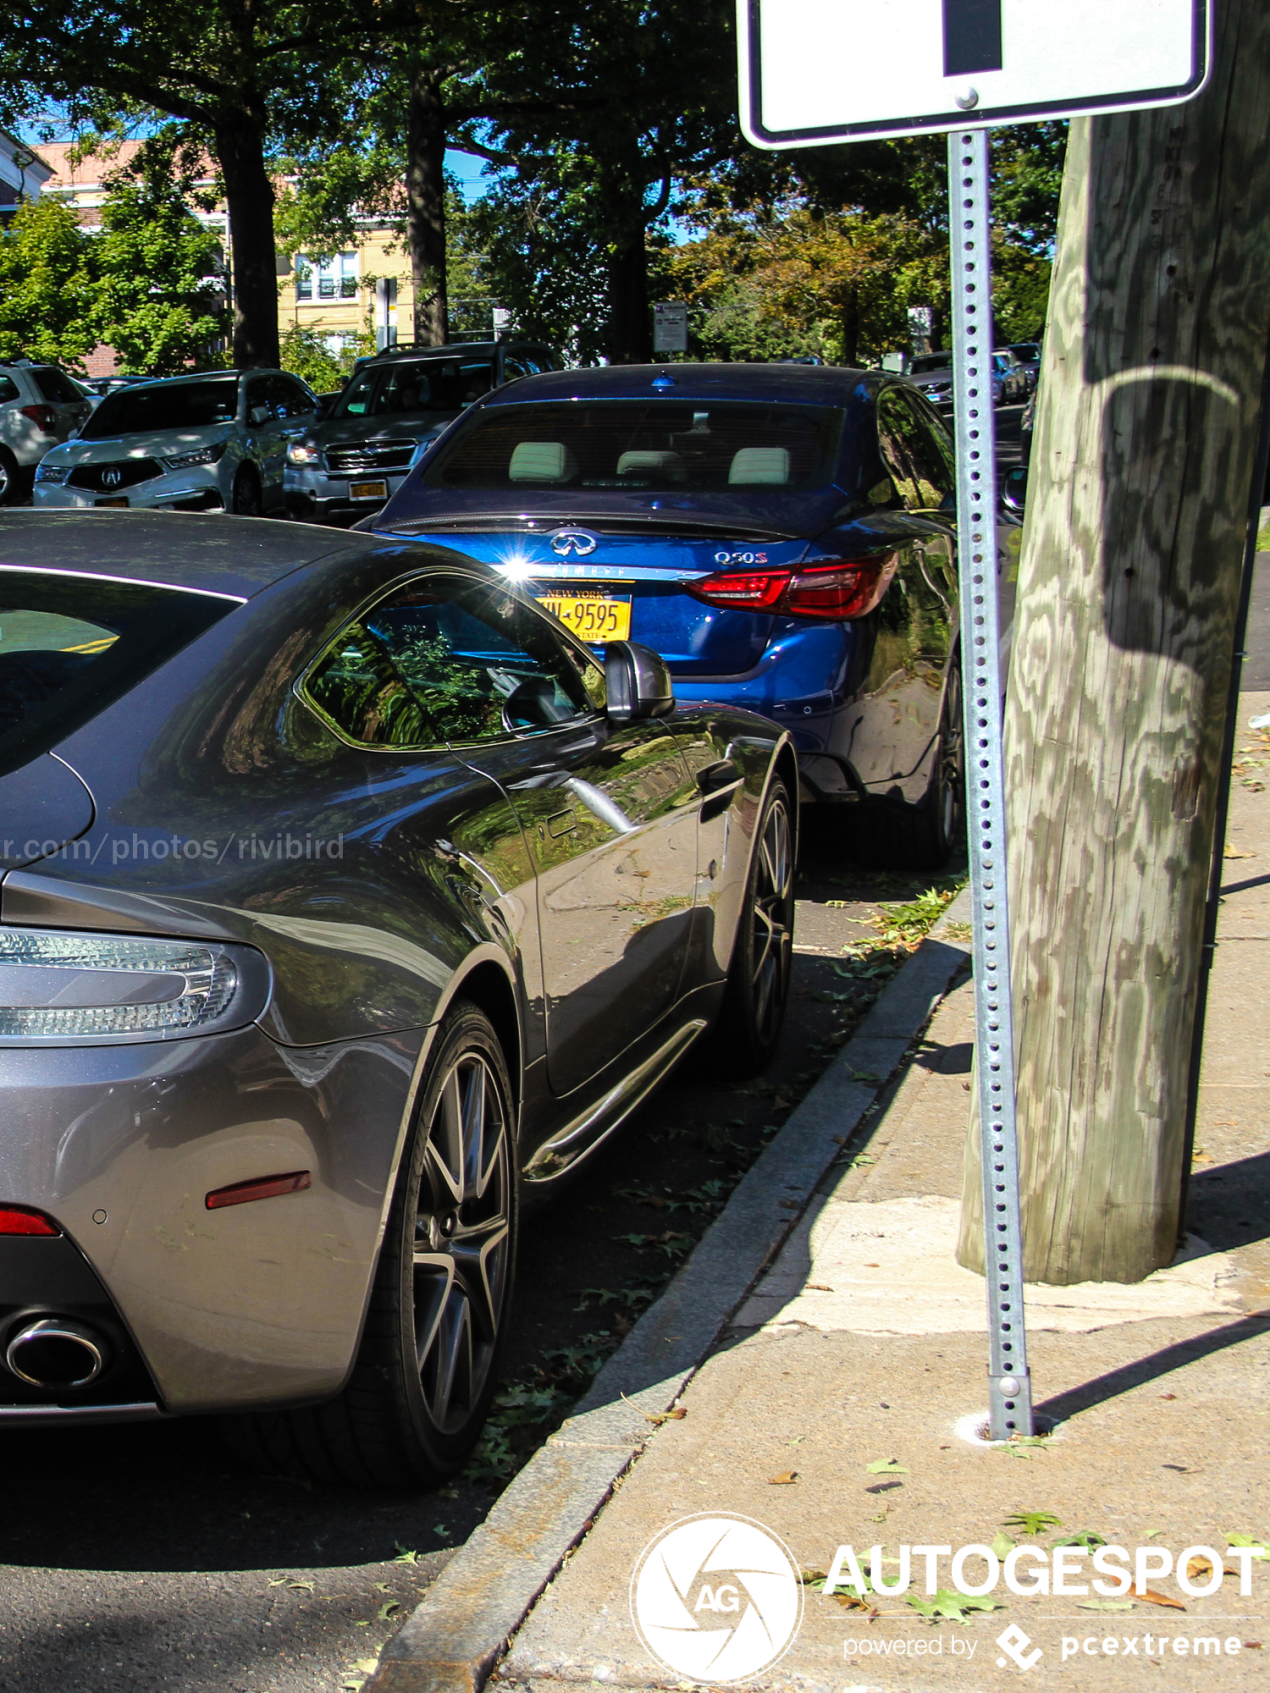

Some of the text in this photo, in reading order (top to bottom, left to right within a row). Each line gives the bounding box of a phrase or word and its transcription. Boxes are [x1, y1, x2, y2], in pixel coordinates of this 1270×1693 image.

[714, 552, 768, 566] Q50S
[548, 589, 604, 599] NEW YORK
[575, 603, 618, 631] 9595
